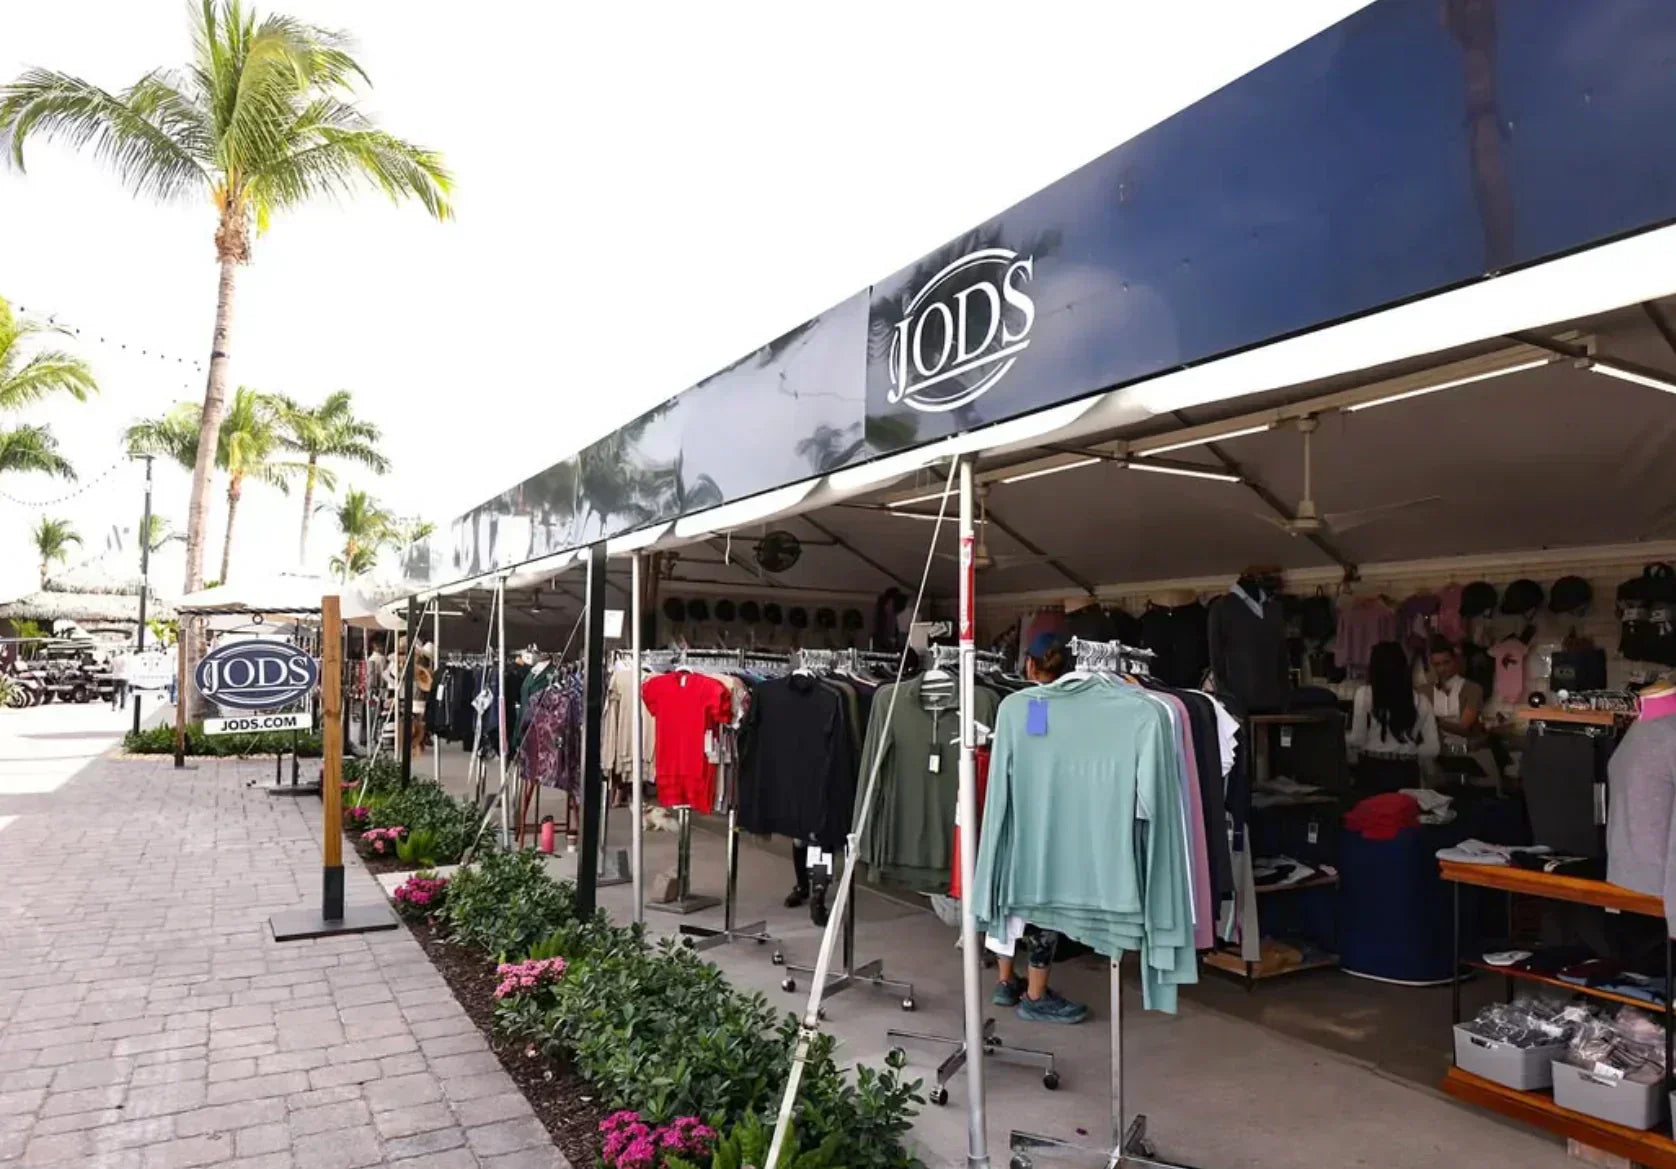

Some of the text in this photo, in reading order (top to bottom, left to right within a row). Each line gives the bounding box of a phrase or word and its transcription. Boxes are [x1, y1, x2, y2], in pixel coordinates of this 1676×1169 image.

[887, 254, 1035, 404] JODS
[202, 656, 310, 694] JODS
[221, 716, 297, 731] JODS.COM
